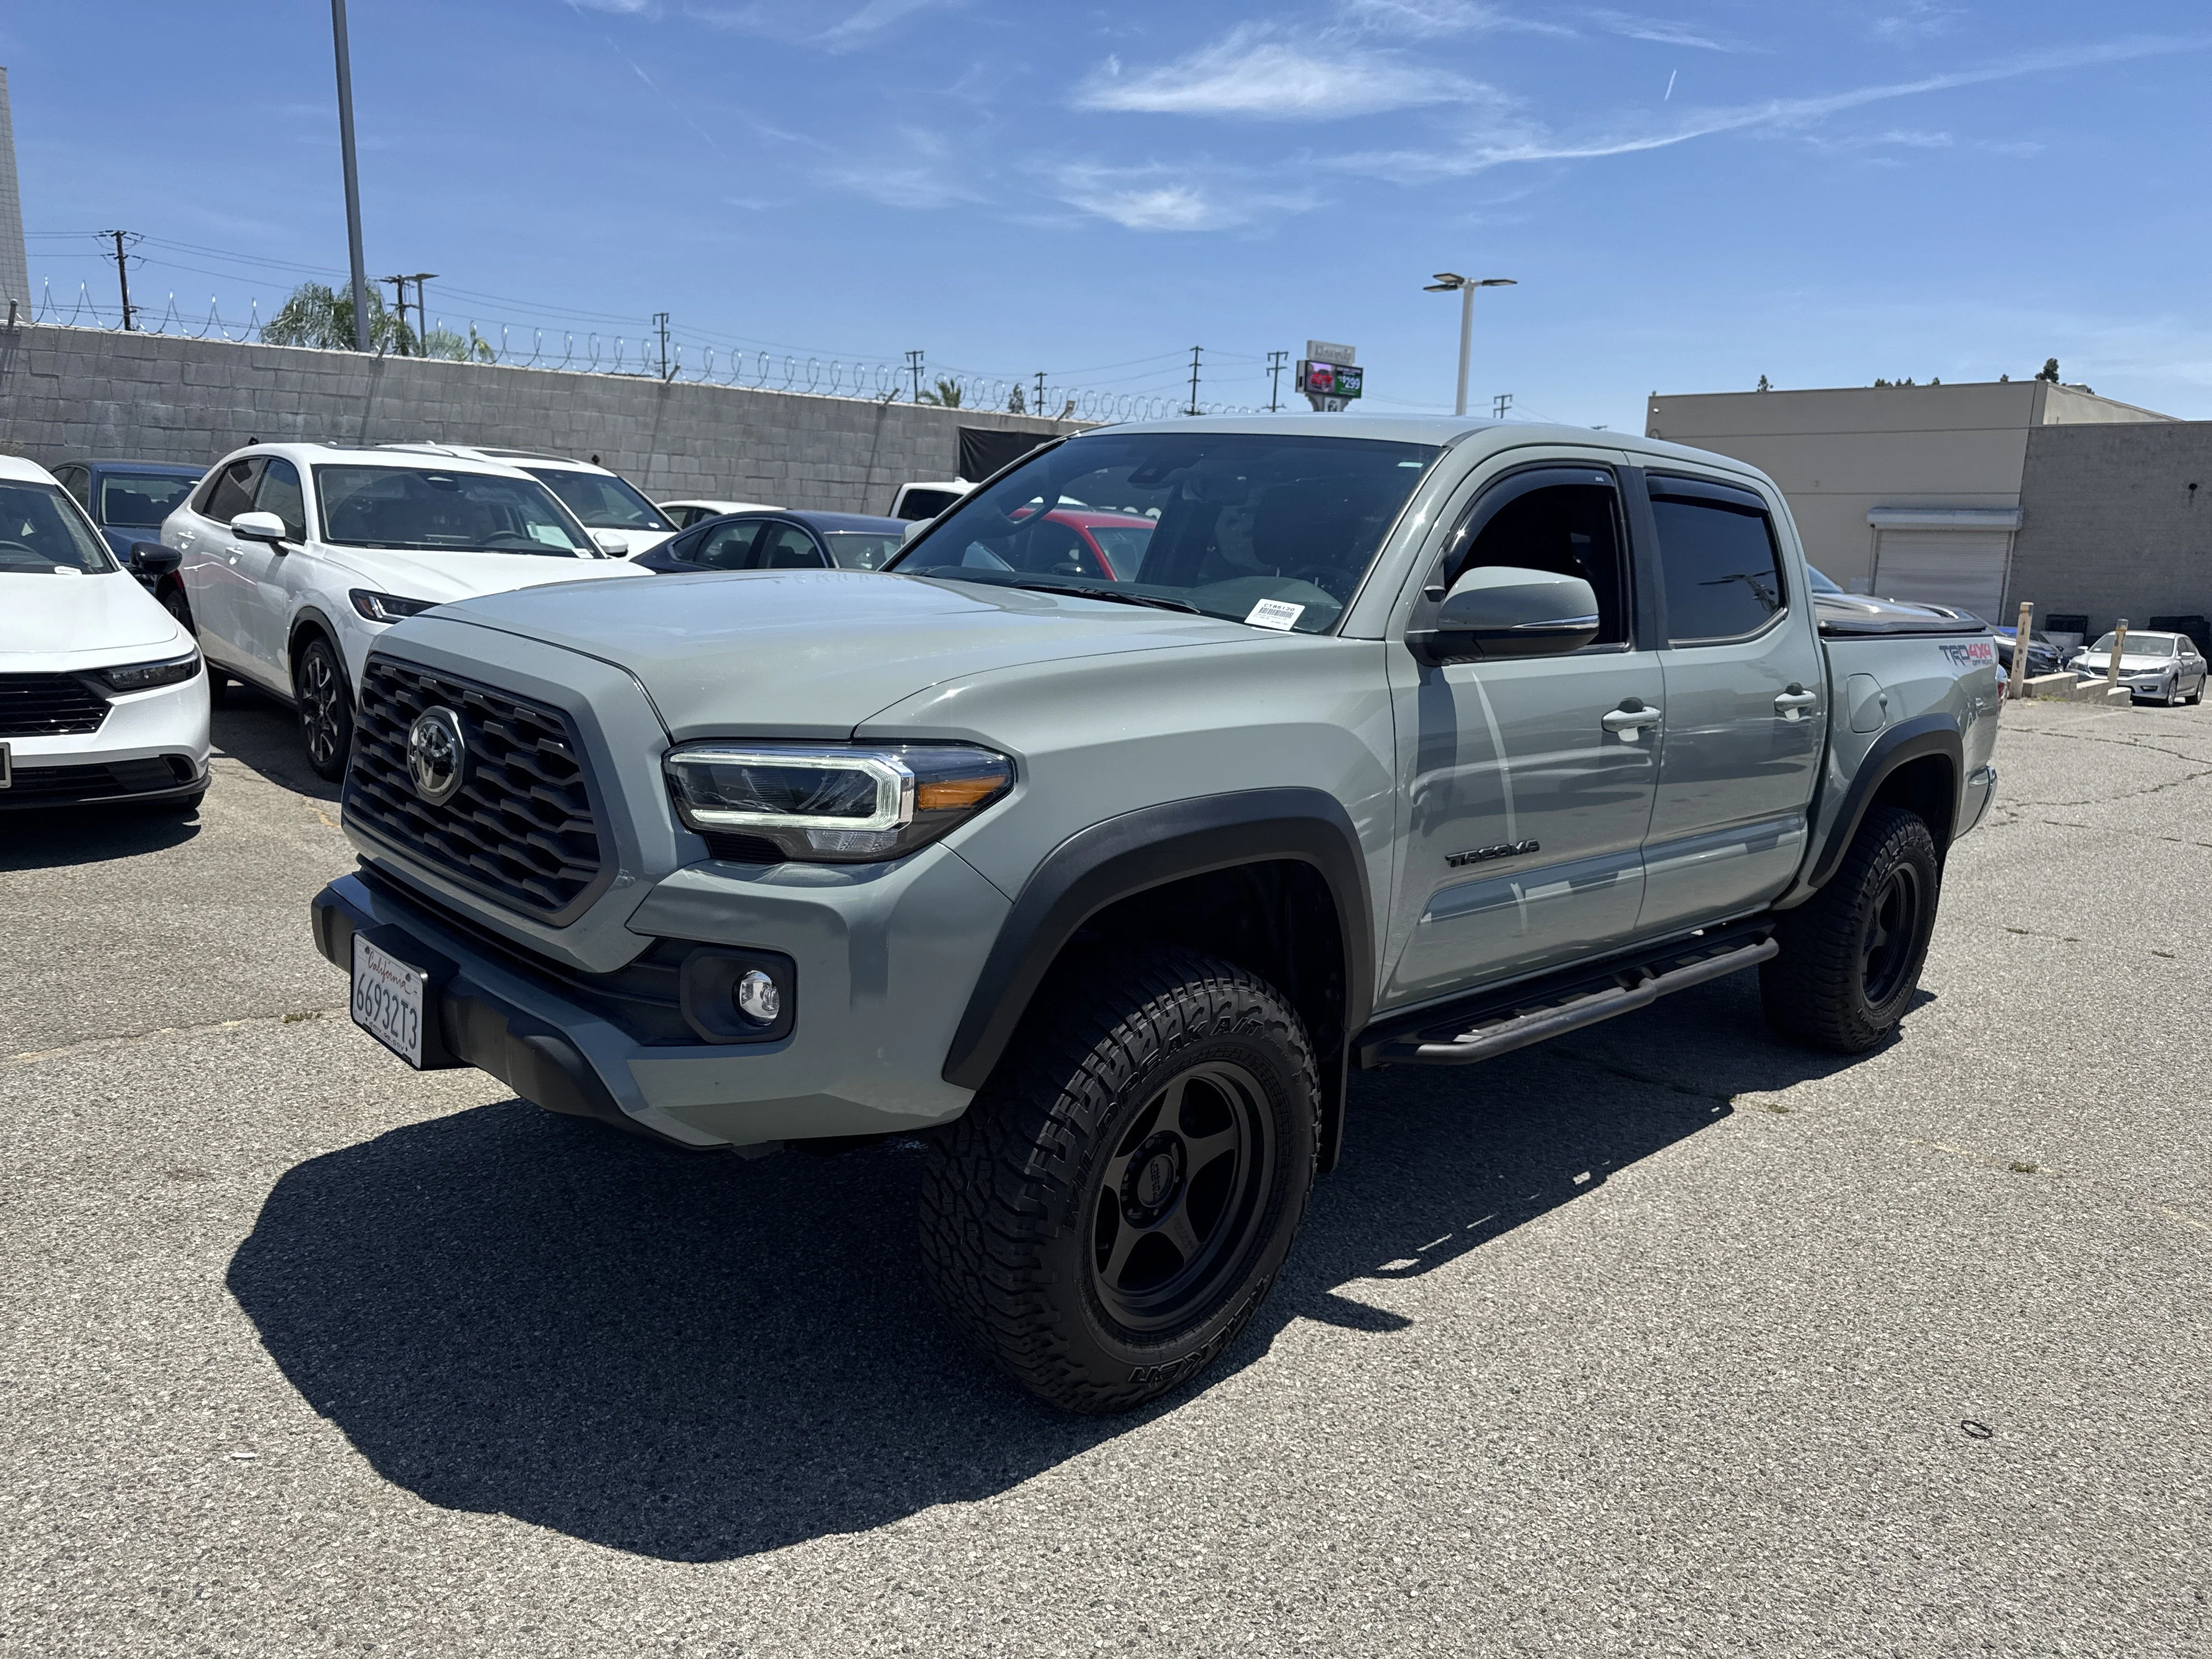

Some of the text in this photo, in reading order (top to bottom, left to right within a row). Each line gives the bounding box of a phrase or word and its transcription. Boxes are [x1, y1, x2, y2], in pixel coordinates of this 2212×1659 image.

[1939, 645, 1970, 667] TRD
[1445, 839, 1541, 867] TACOMA
[368, 951, 411, 995] California
[356, 973, 417, 1049] 66932T3
[369, 1021, 404, 1052] dmv.ca.gov
[1062, 1015, 1265, 1234] WILDPEAK A/T
[1127, 1274, 1270, 1389] FALKEN
